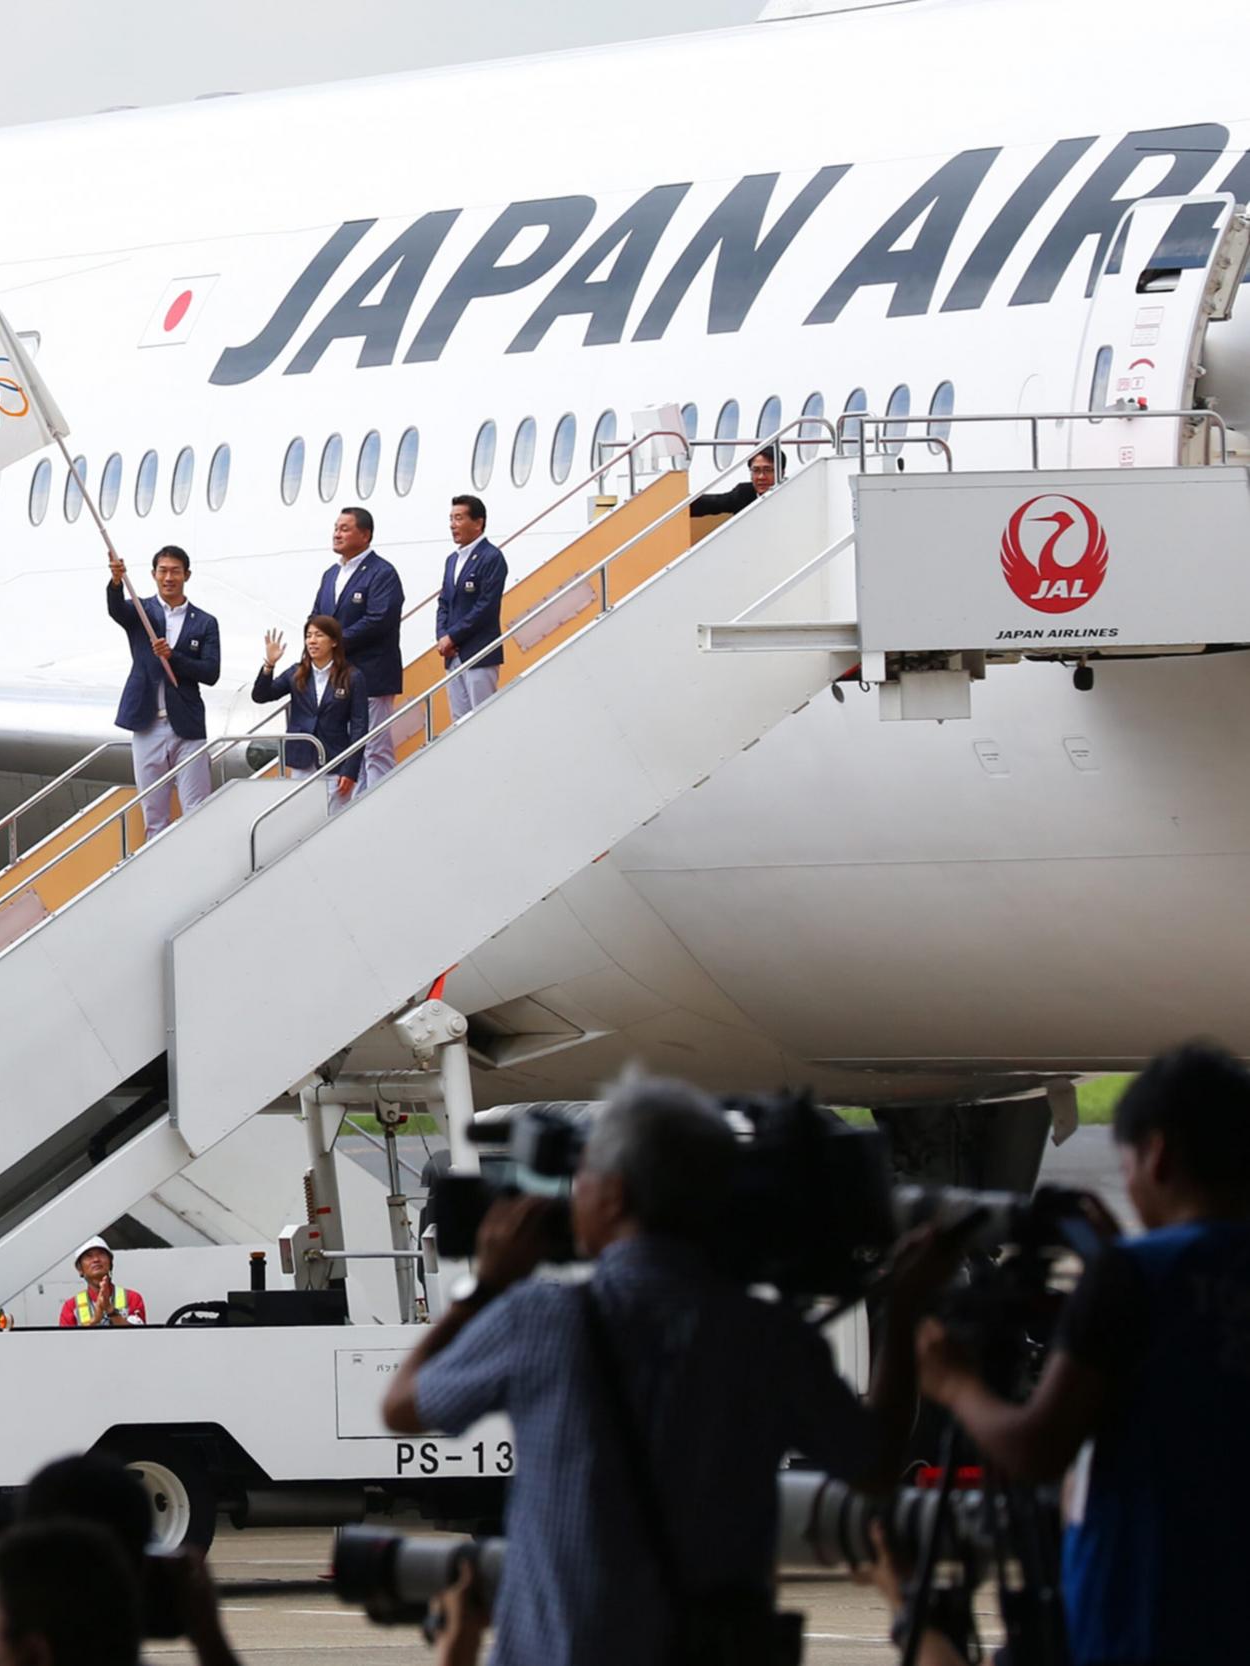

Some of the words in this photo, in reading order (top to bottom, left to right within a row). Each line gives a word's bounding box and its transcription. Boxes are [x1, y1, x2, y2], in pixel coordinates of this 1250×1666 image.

[209, 163, 853, 386] JAPAN
[1030, 579, 1089, 599] JAL
[995, 629, 1044, 641] JAPAN
[1047, 627, 1119, 639] AIRLINES
[396, 1441, 514, 1475] PS-13
